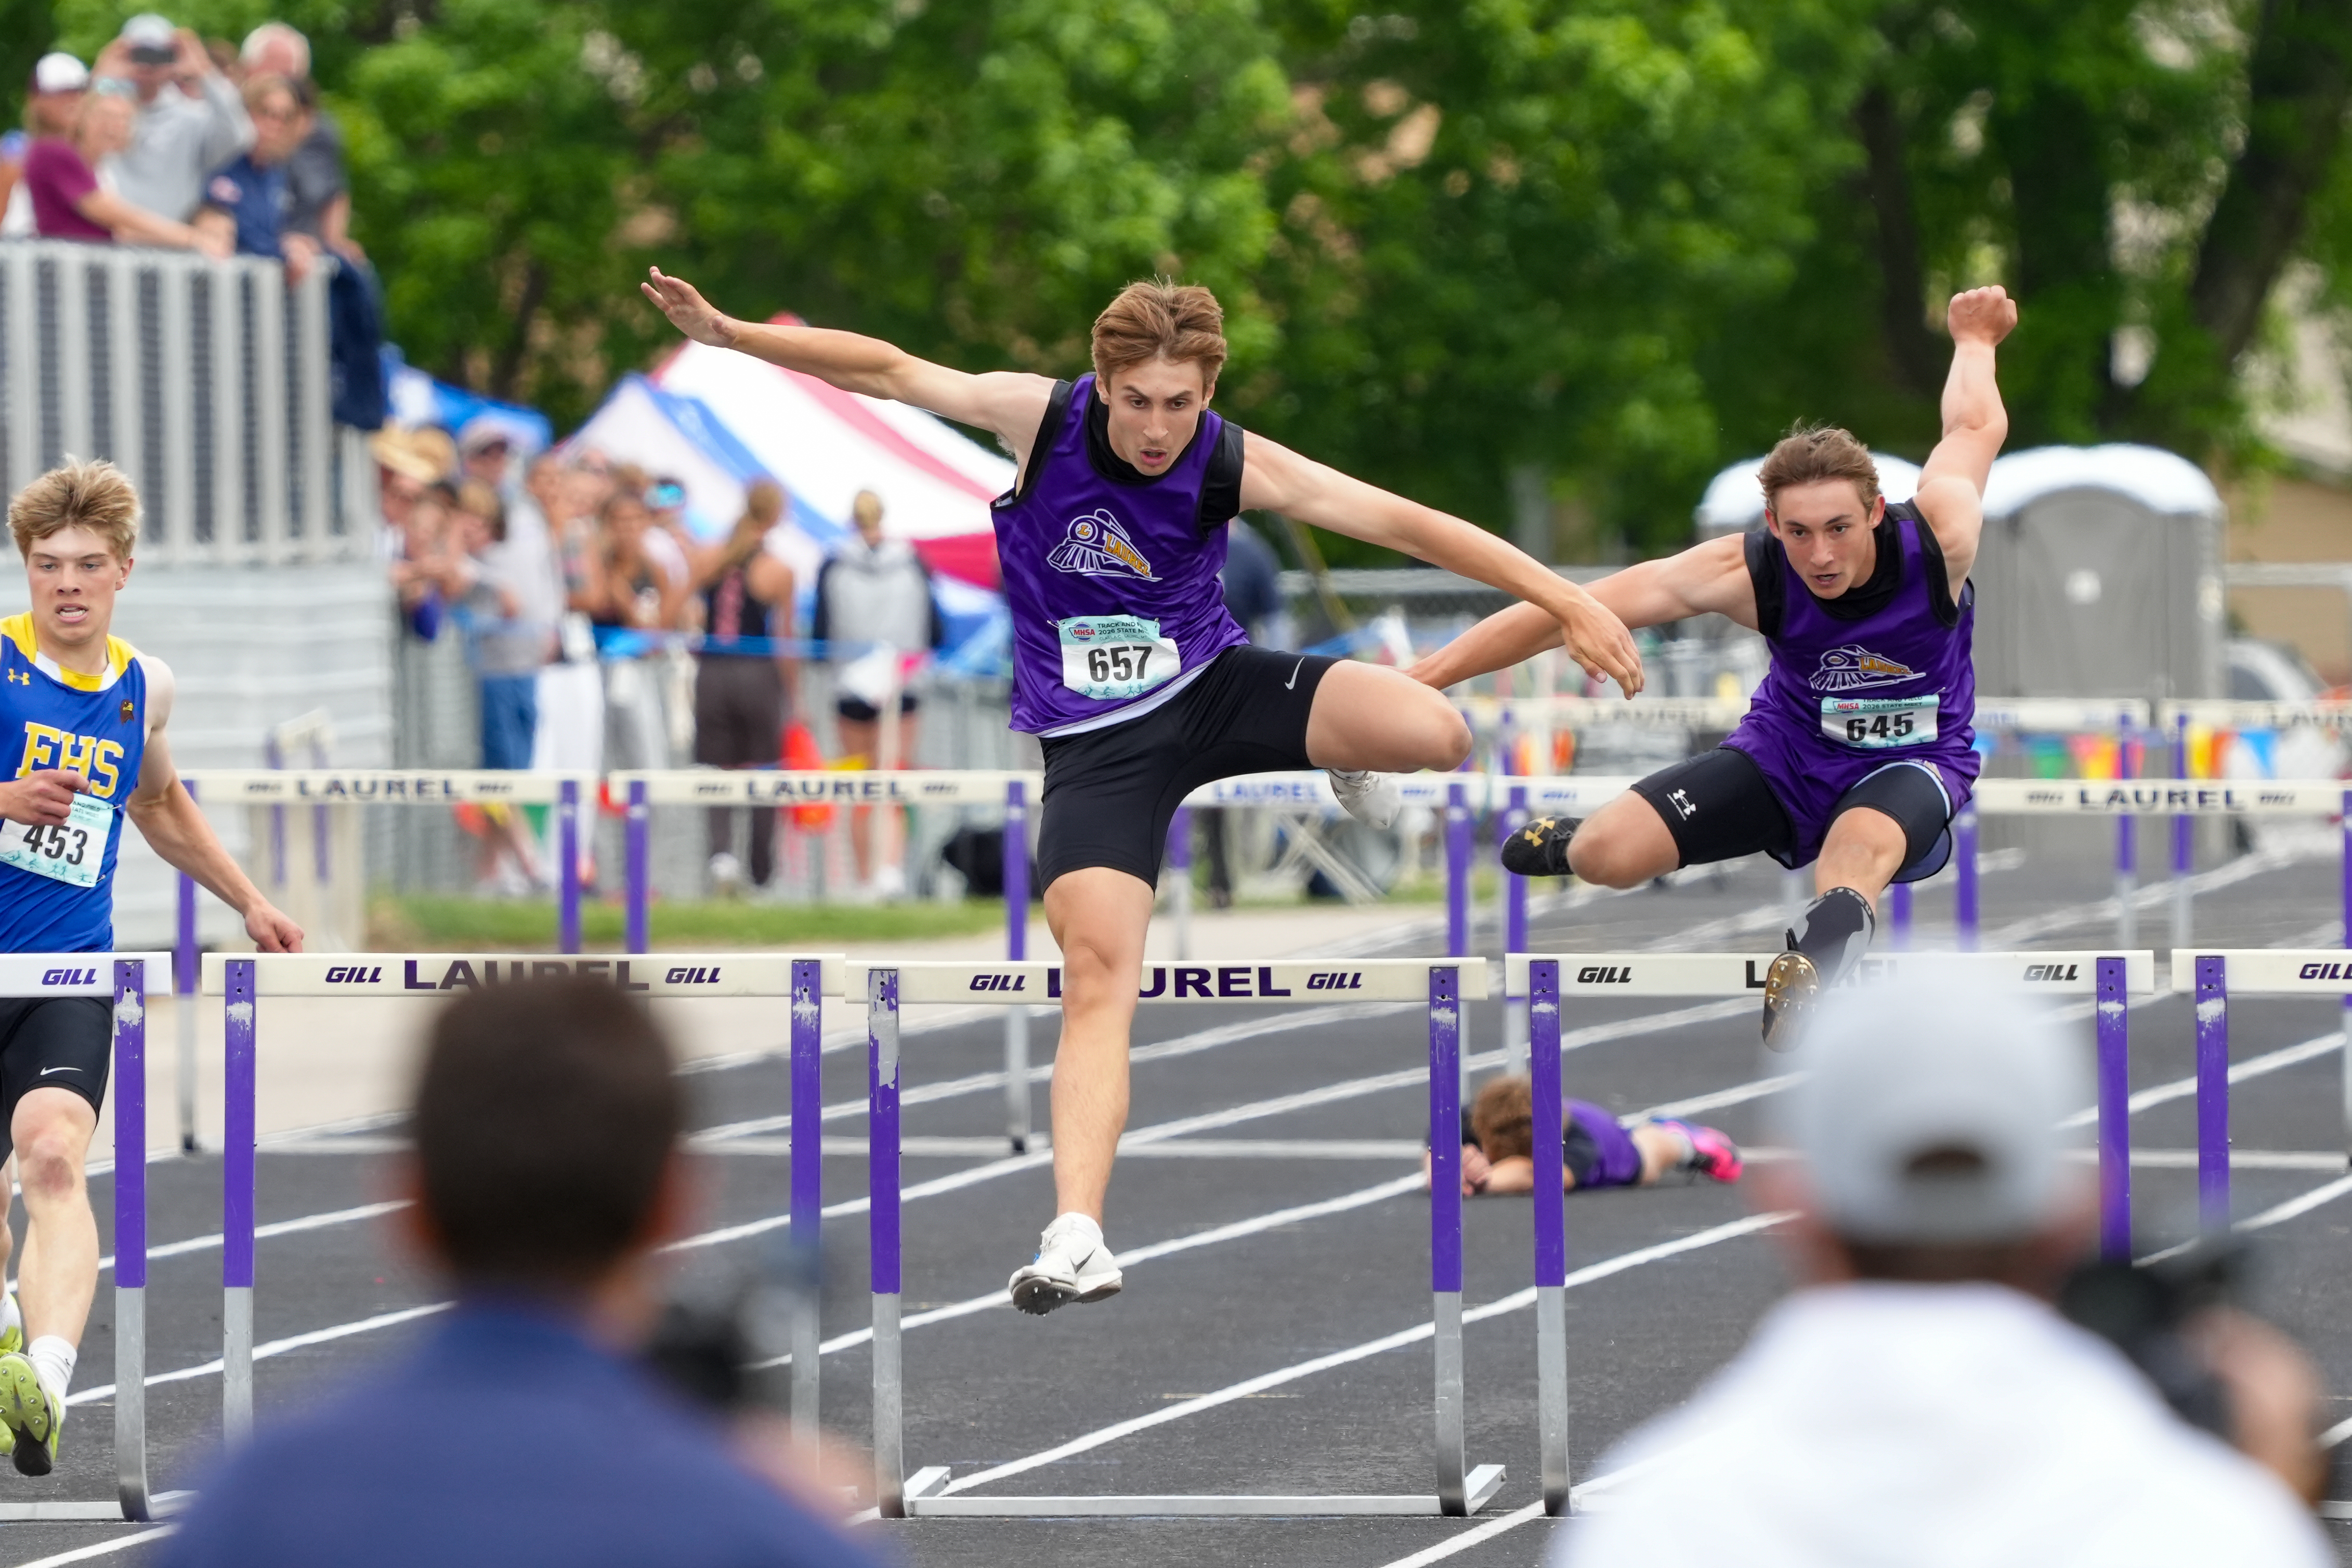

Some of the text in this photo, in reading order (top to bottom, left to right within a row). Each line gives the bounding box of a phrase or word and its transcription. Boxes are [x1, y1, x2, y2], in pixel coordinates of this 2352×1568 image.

[1077, 525, 1090, 536] L
[1104, 533, 1150, 576] LAUREL
[1088, 646, 1153, 682] 657
[1846, 711, 1914, 741] 645
[2080, 788, 2247, 809] LAUREL
[23, 825, 87, 865] 453
[42, 969, 97, 985] GILL
[325, 966, 382, 983] GILL
[665, 967, 721, 984] GILL
[1577, 966, 1632, 983] GILL
[2023, 964, 2079, 981] GILL
[2299, 963, 2352, 979] GILL
[970, 967, 1362, 998] GILL LUREL GILL
